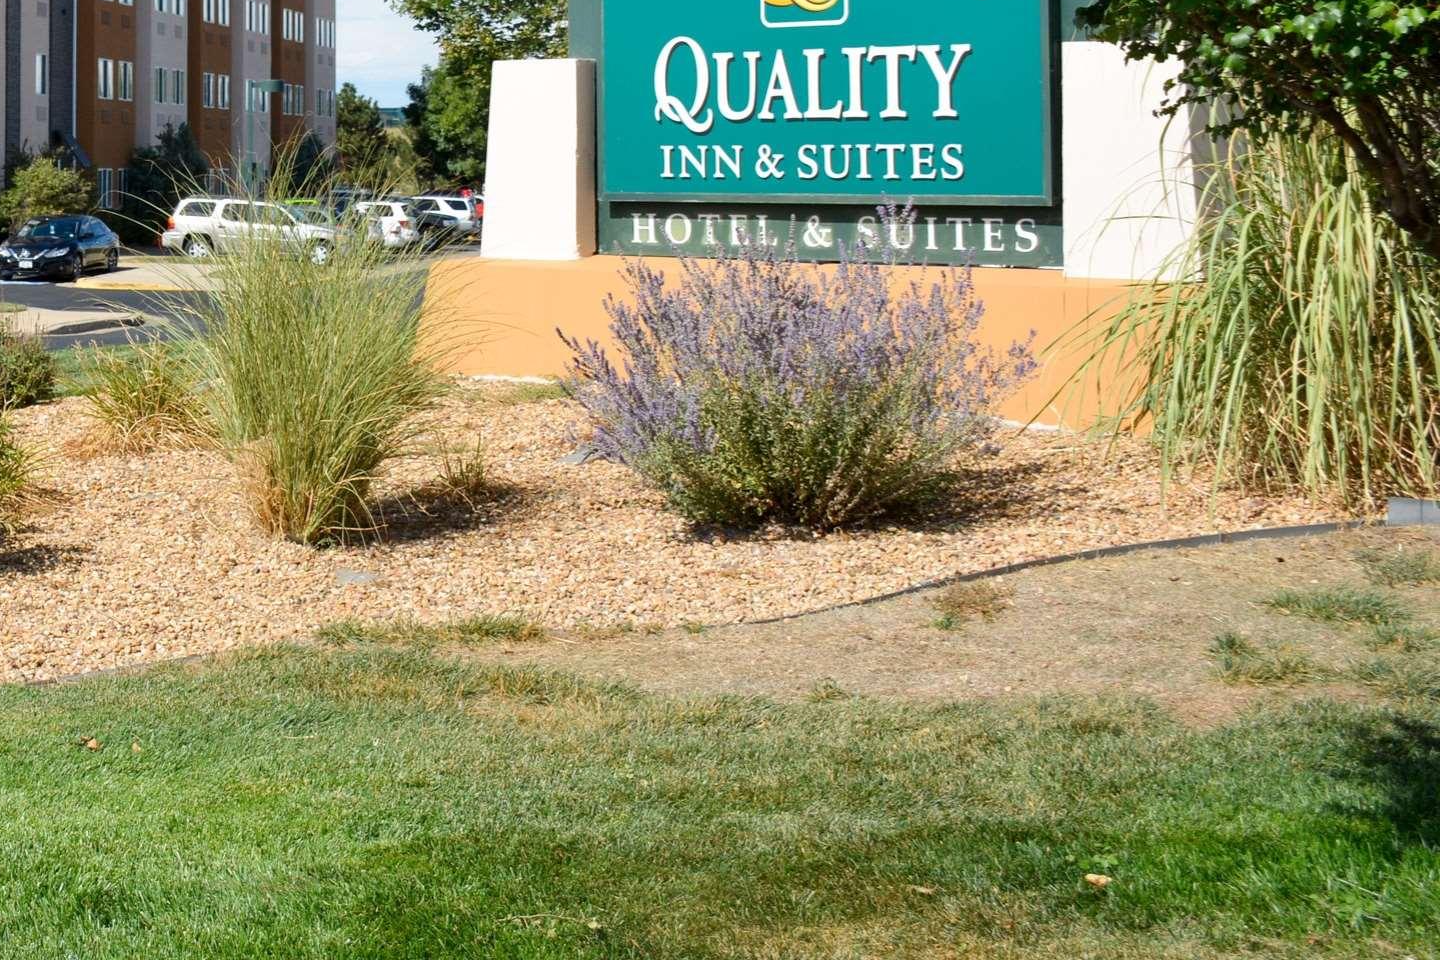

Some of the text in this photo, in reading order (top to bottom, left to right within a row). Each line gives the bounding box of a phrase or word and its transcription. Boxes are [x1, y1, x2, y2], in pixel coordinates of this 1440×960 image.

[654, 36, 972, 133] QUALITY
[660, 143, 965, 180] INN & SUITES
[630, 212, 1040, 253] HOTEL & SUITES
